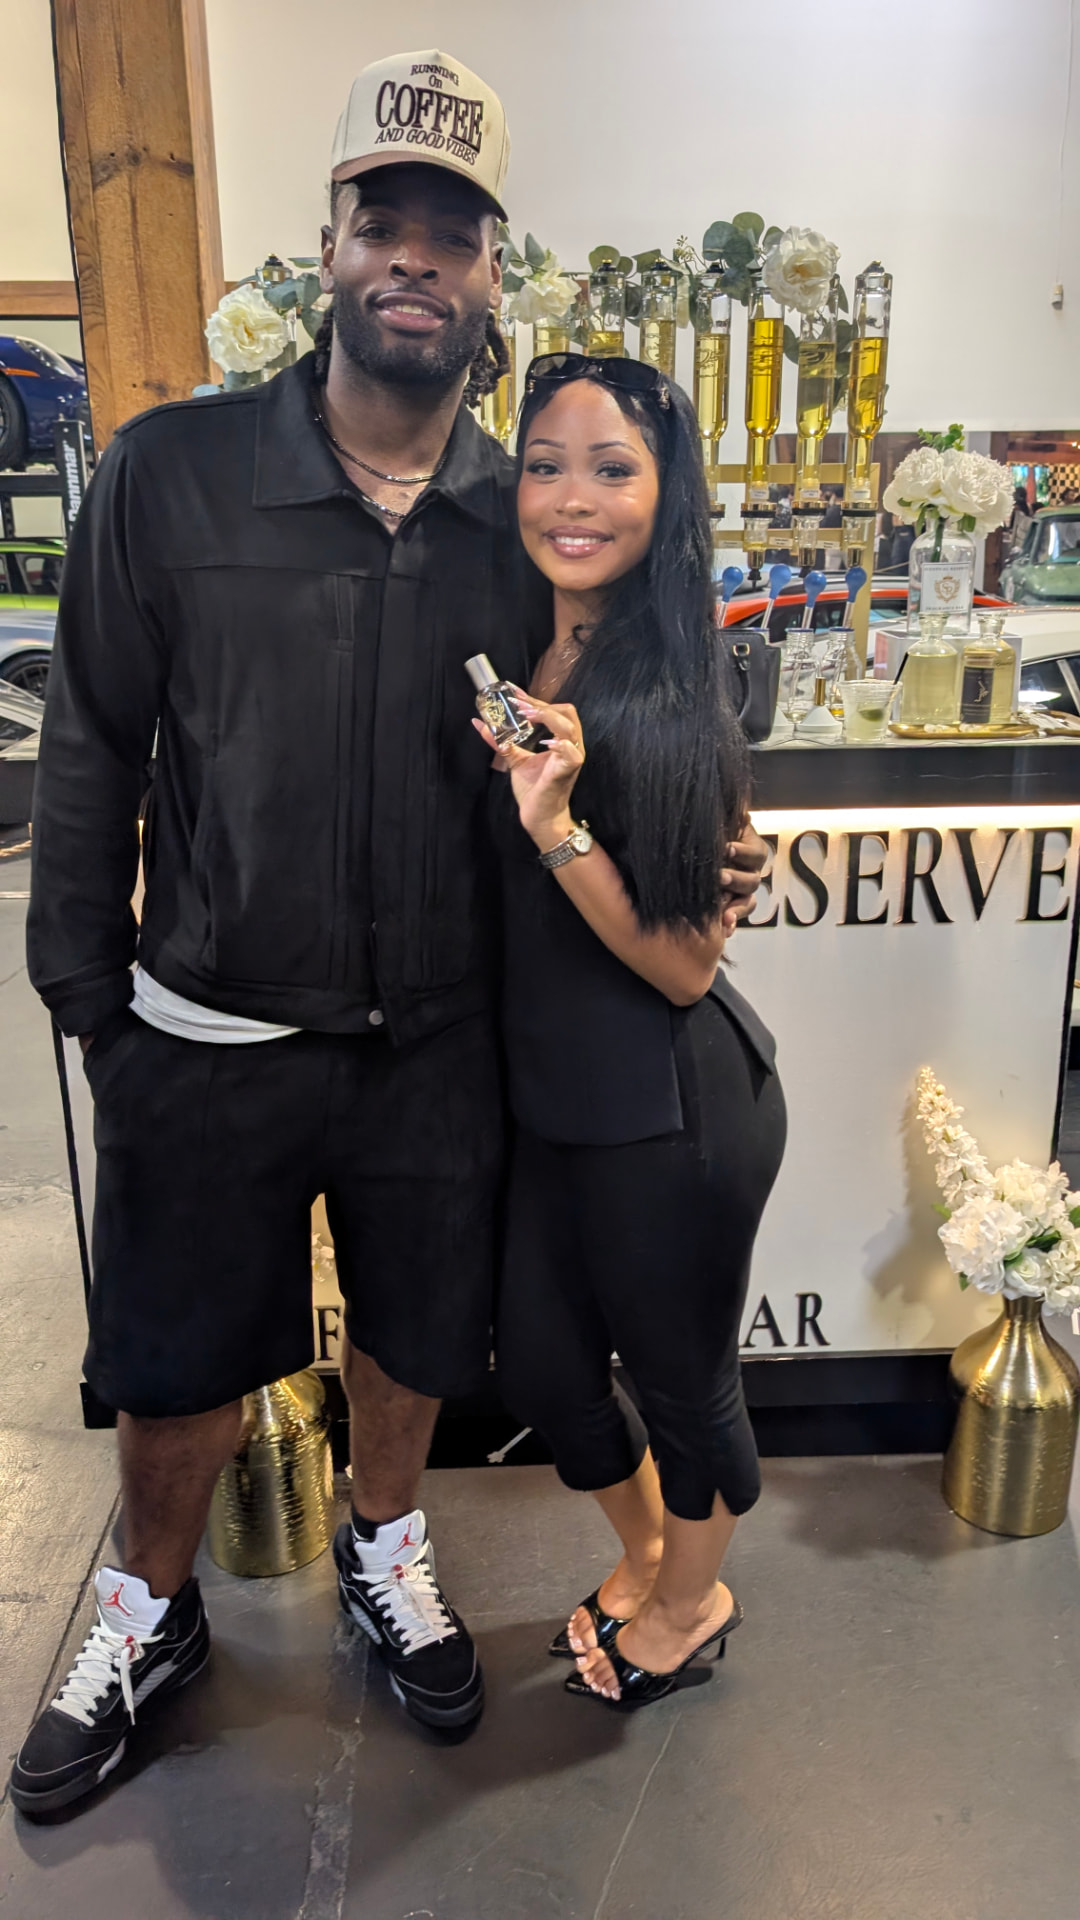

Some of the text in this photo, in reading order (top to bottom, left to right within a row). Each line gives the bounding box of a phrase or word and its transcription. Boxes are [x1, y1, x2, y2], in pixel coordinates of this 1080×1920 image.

[410, 64, 459, 86] RUNNING
[428, 75, 443, 89] On
[375, 80, 484, 153] COFFEE
[375, 127, 477, 165] AND GOOD VIBES
[736, 827, 1073, 928] ESERVE
[739, 1292, 831, 1348] AR
